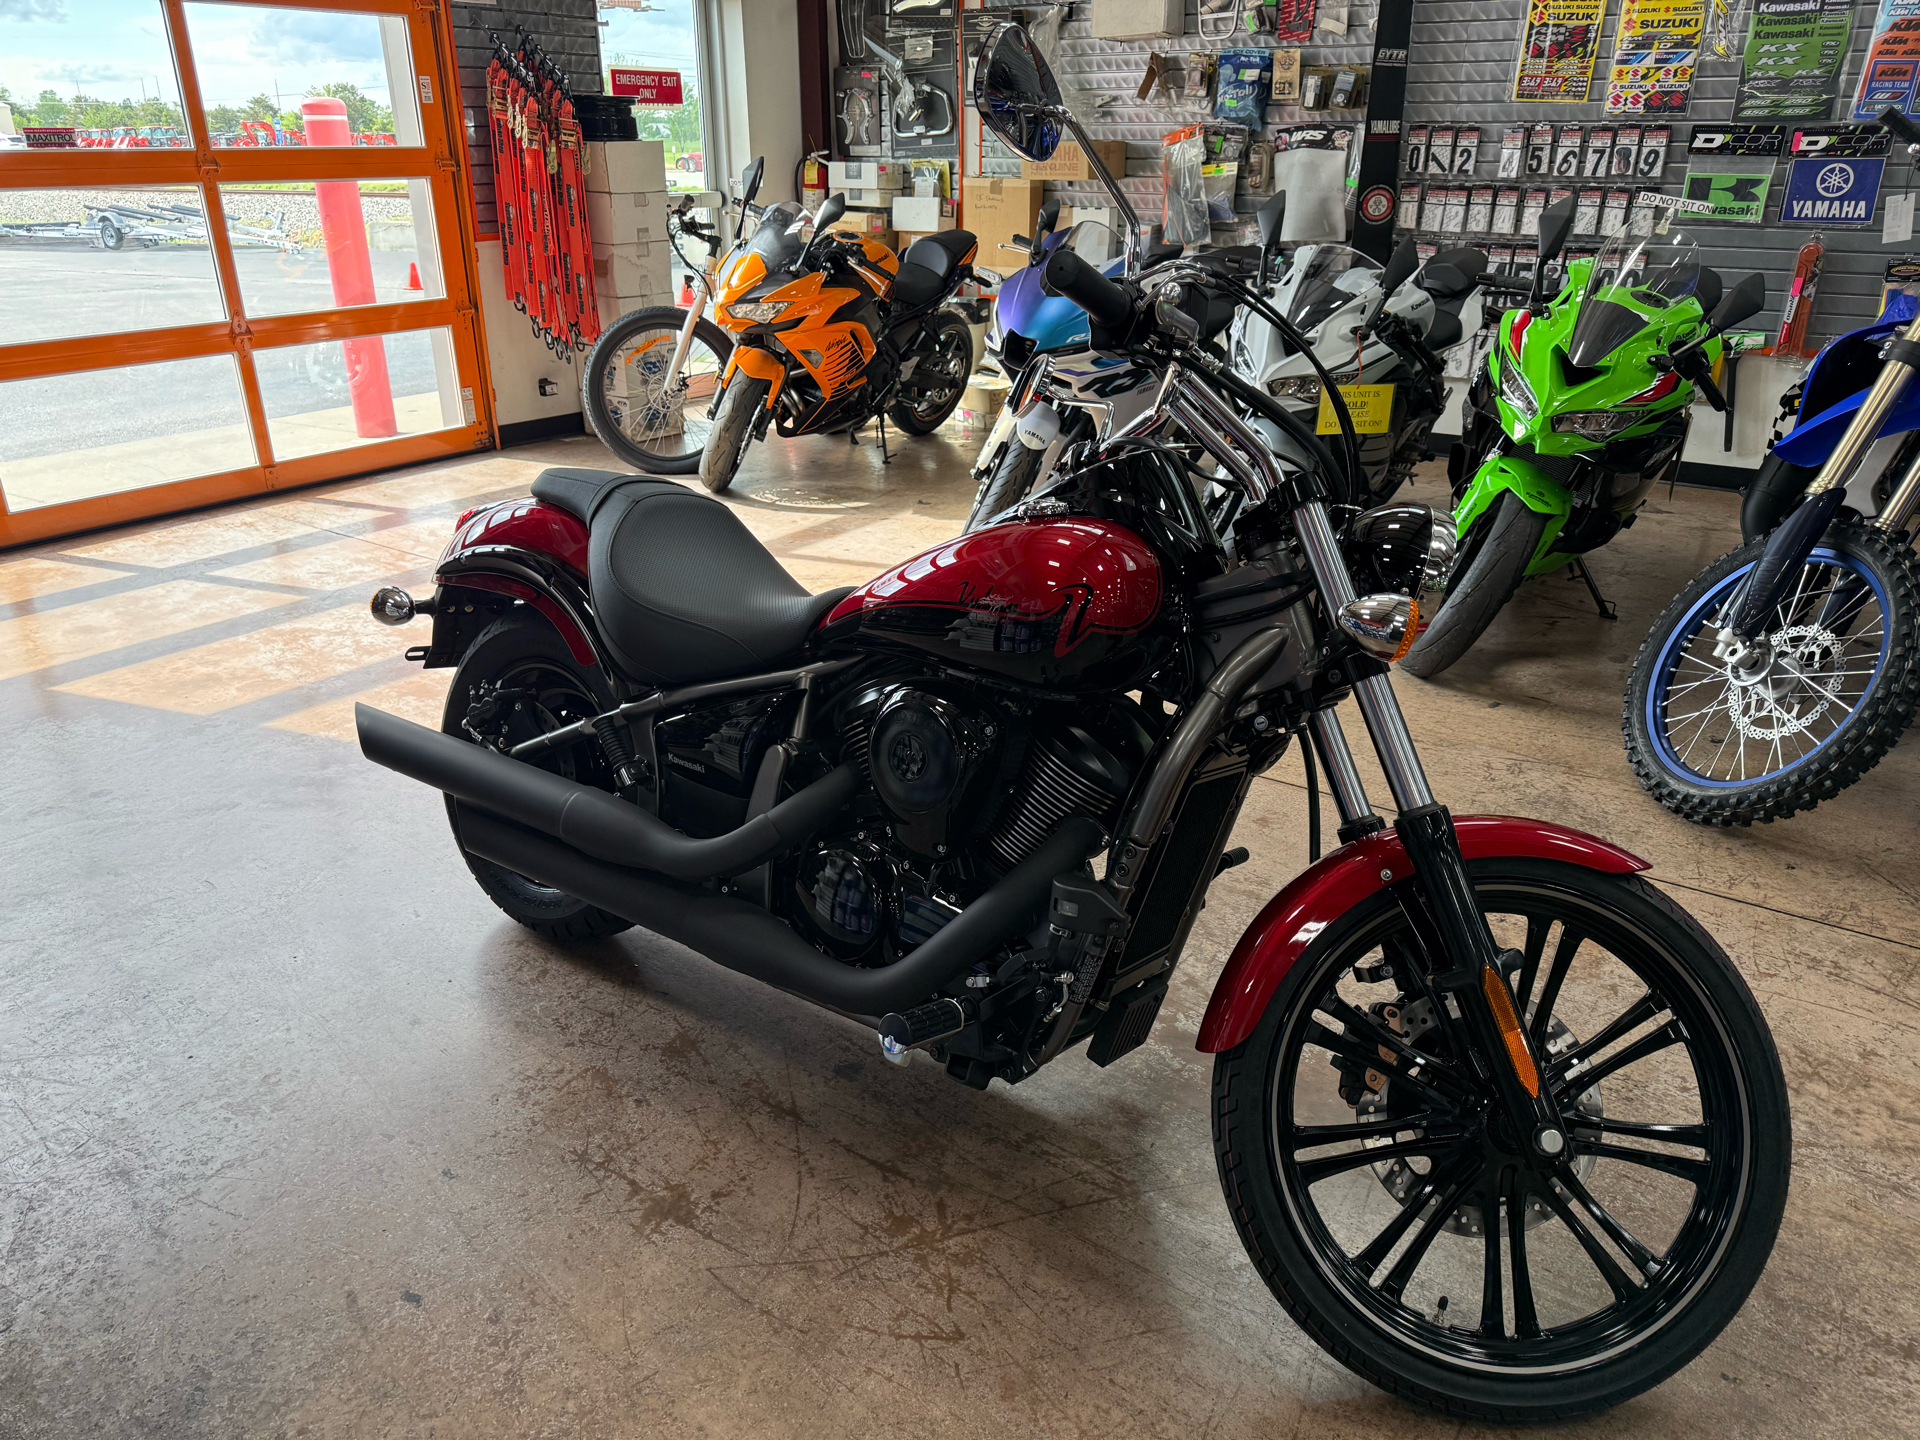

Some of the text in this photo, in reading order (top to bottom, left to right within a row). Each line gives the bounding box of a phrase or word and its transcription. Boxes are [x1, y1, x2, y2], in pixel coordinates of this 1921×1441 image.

[1759, 1, 1820, 13] Kawasaki
[1640, 18, 1699, 29] SUZUKI
[1756, 14, 1818, 26] Kawasaki
[1754, 28, 1815, 40] Kawasaki
[1881, 36, 1910, 45] KTM
[1377, 48, 1407, 60] GYTR
[1757, 42, 1808, 53] KX
[1755, 56, 1806, 66] KX
[1878, 68, 1909, 77] KTM
[616, 74, 677, 87] EMERGENCY EXIT
[640, 88, 656, 98] ONLY
[1370, 120, 1400, 134] YAMALUBE
[1456, 148, 1472, 174] 2
[1528, 146, 1544, 173] 5
[1556, 150, 1578, 176] 6
[1591, 148, 1607, 176] 7
[1614, 146, 1632, 174] 8
[1639, 149, 1660, 176] 9
[1642, 194, 1654, 203] DO
[1658, 196, 1680, 208] NOT
[1680, 201, 1696, 210] SIT
[1698, 204, 1713, 214] ON
[1792, 200, 1866, 218] YAMAHA
[1350, 410, 1370, 418] EASE
[1024, 430, 1046, 444] YAMAHA
[668, 752, 706, 774] Kawasaki
